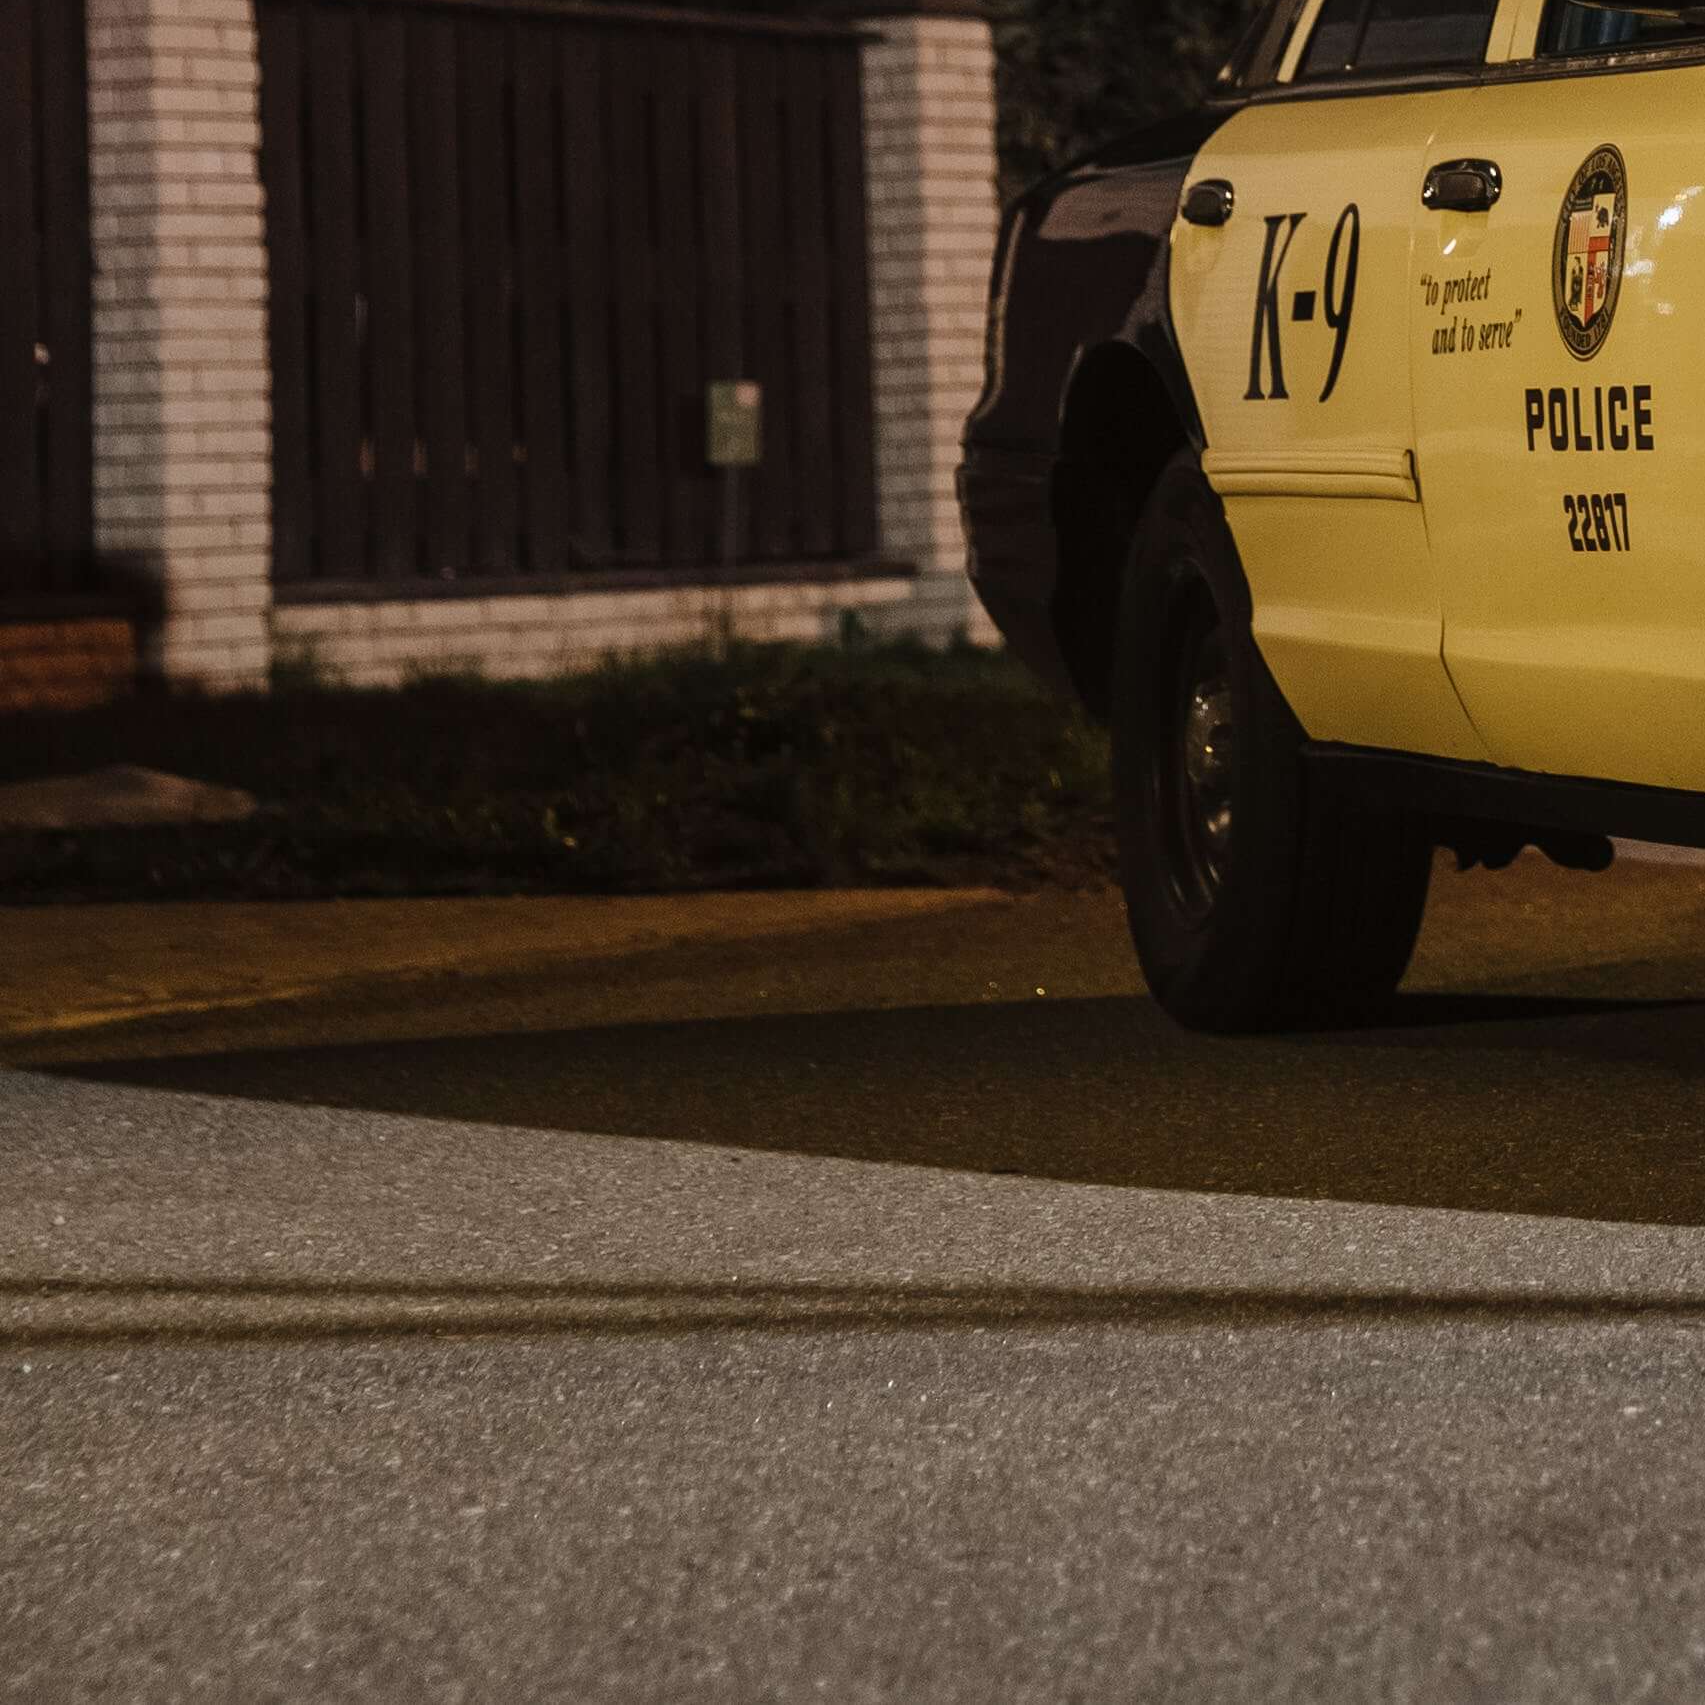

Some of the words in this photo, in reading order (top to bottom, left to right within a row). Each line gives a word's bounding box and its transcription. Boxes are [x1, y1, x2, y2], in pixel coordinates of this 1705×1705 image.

[1243, 202, 1360, 404] K-9
[1440, 267, 1491, 316] protect
[1432, 315, 1458, 355] and
[1461, 317, 1475, 352] to
[1525, 385, 1654, 452] POLICE
[1563, 492, 1631, 552] 22817
